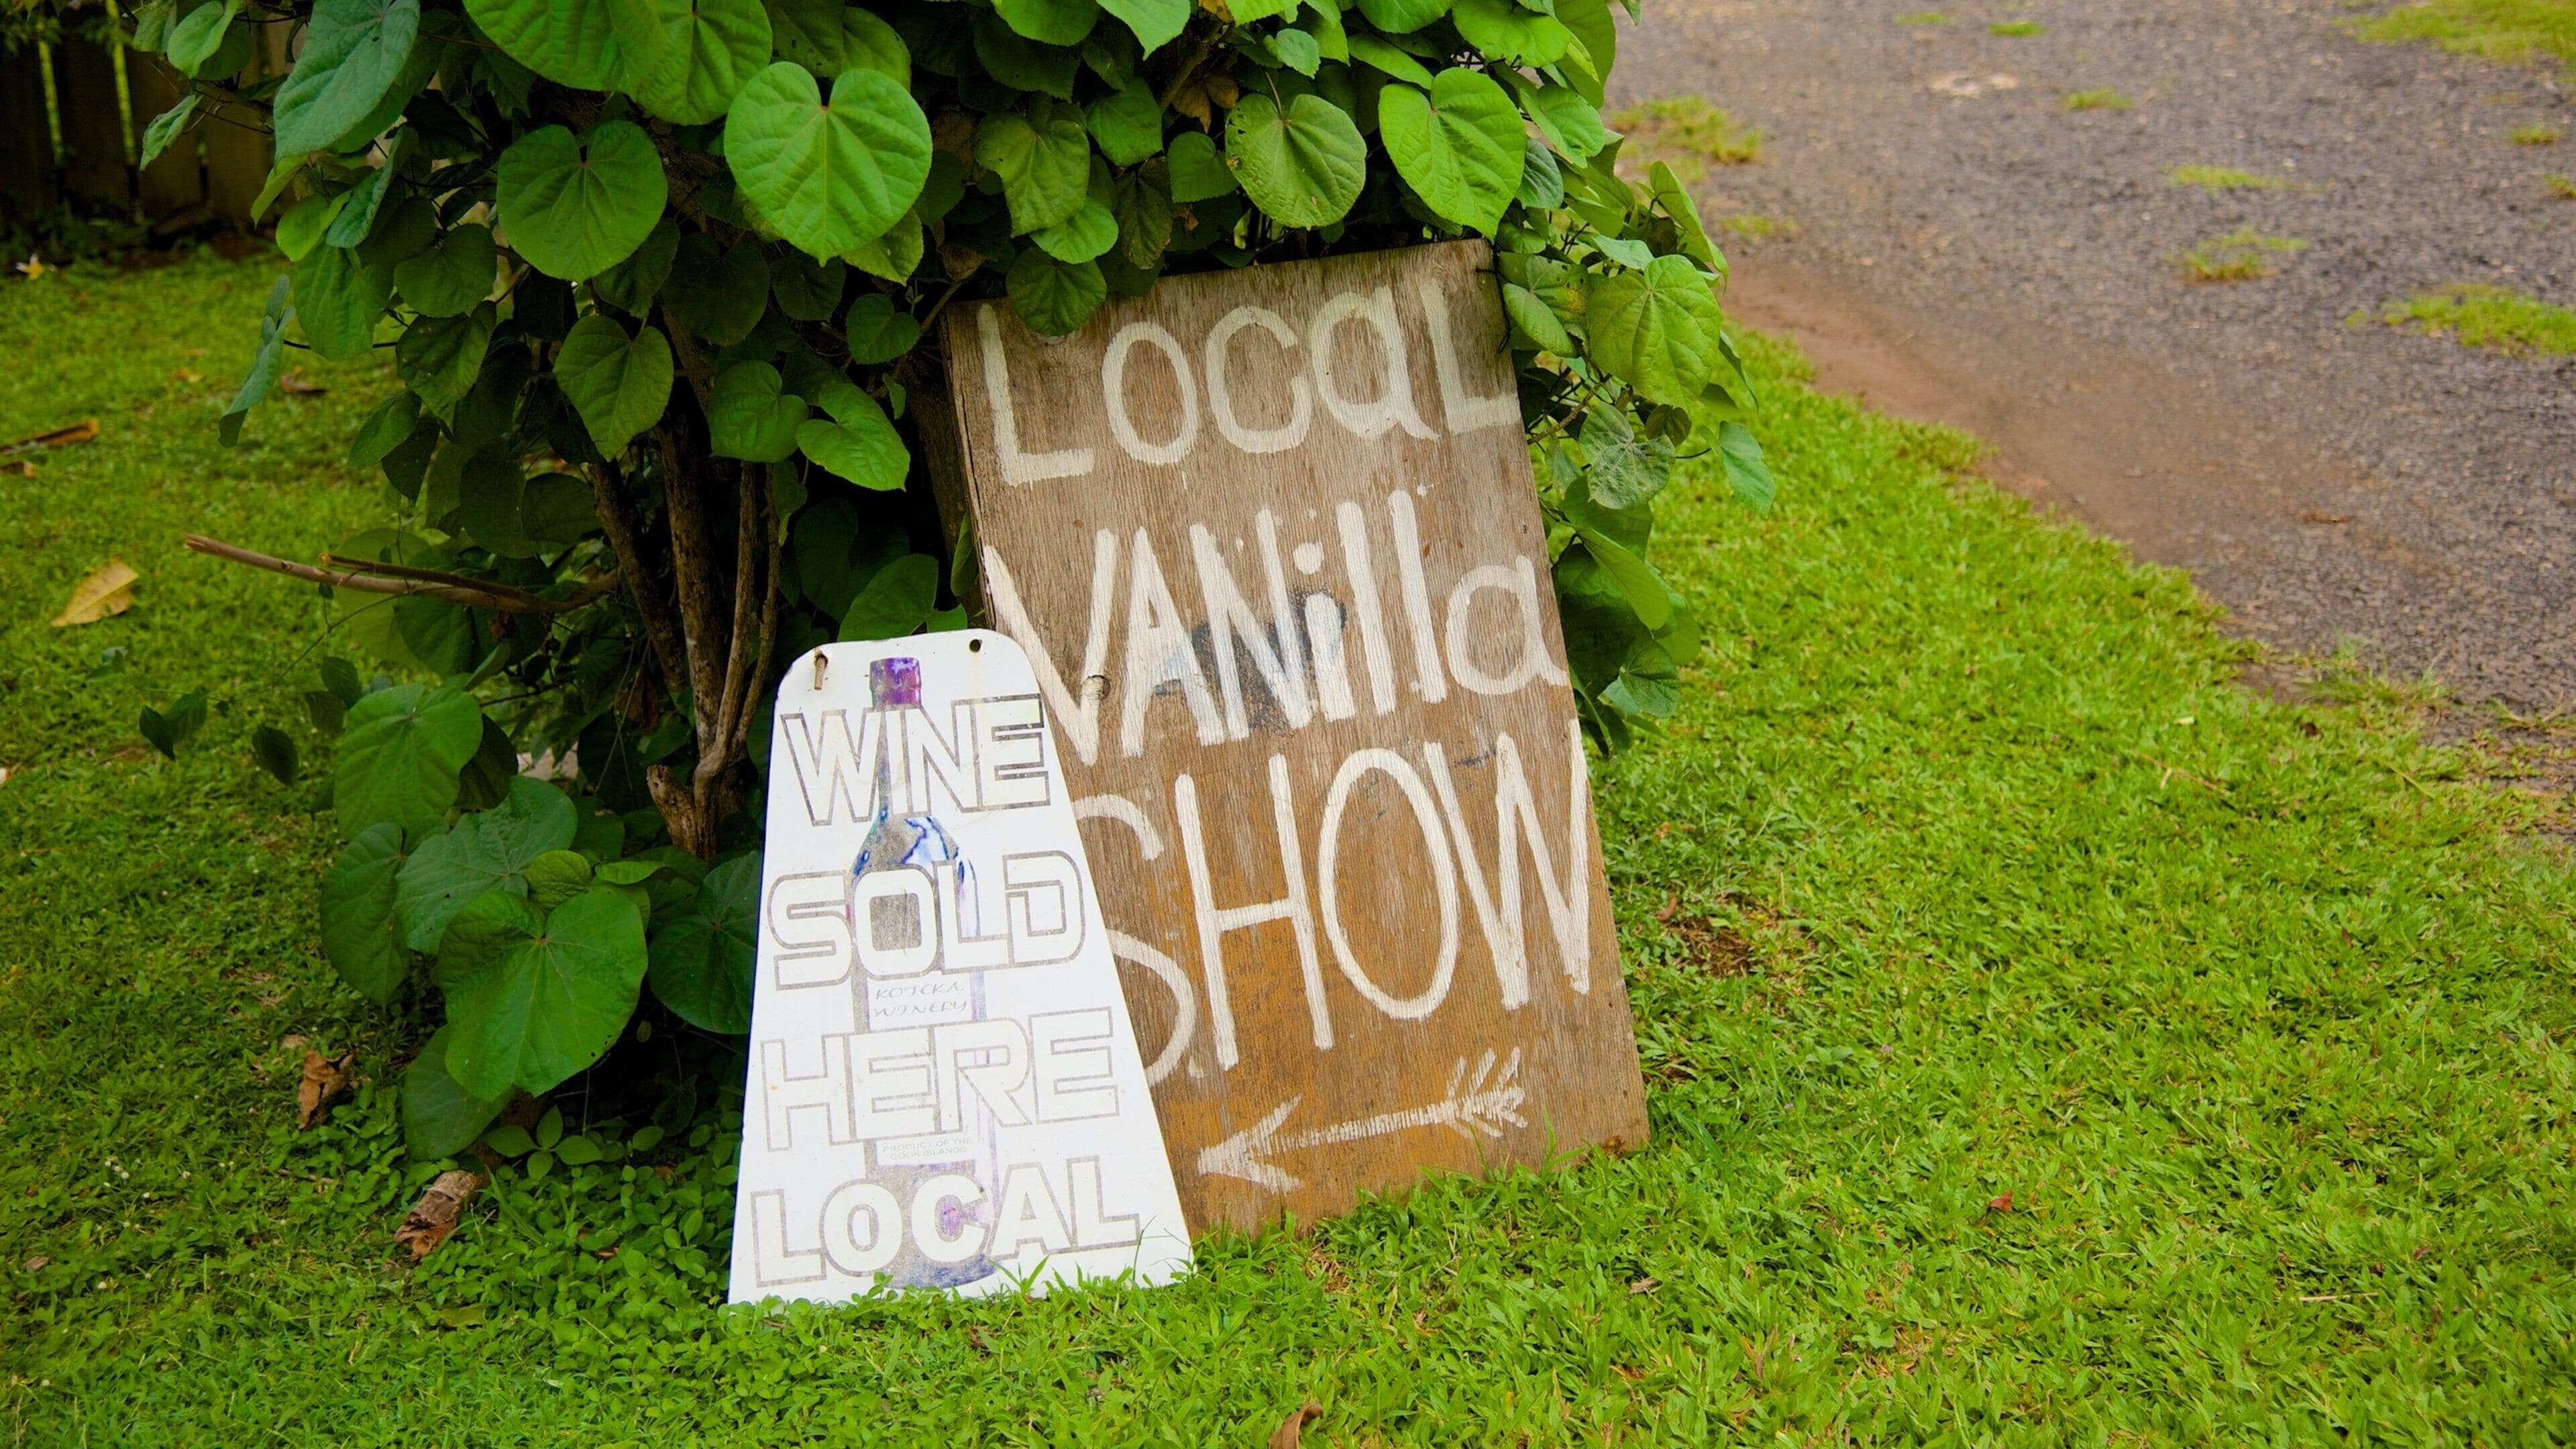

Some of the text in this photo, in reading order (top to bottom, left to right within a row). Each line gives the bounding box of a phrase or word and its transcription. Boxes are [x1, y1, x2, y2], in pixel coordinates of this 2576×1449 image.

[780, 693, 1051, 827] WINE
[767, 850, 1086, 991] SOLD
[1071, 718, 1589, 1087] SHOW
[760, 1006, 1120, 1152] HERE
[935, 1138, 950, 1148] OF
[749, 1155, 1141, 1288] LOCAL
